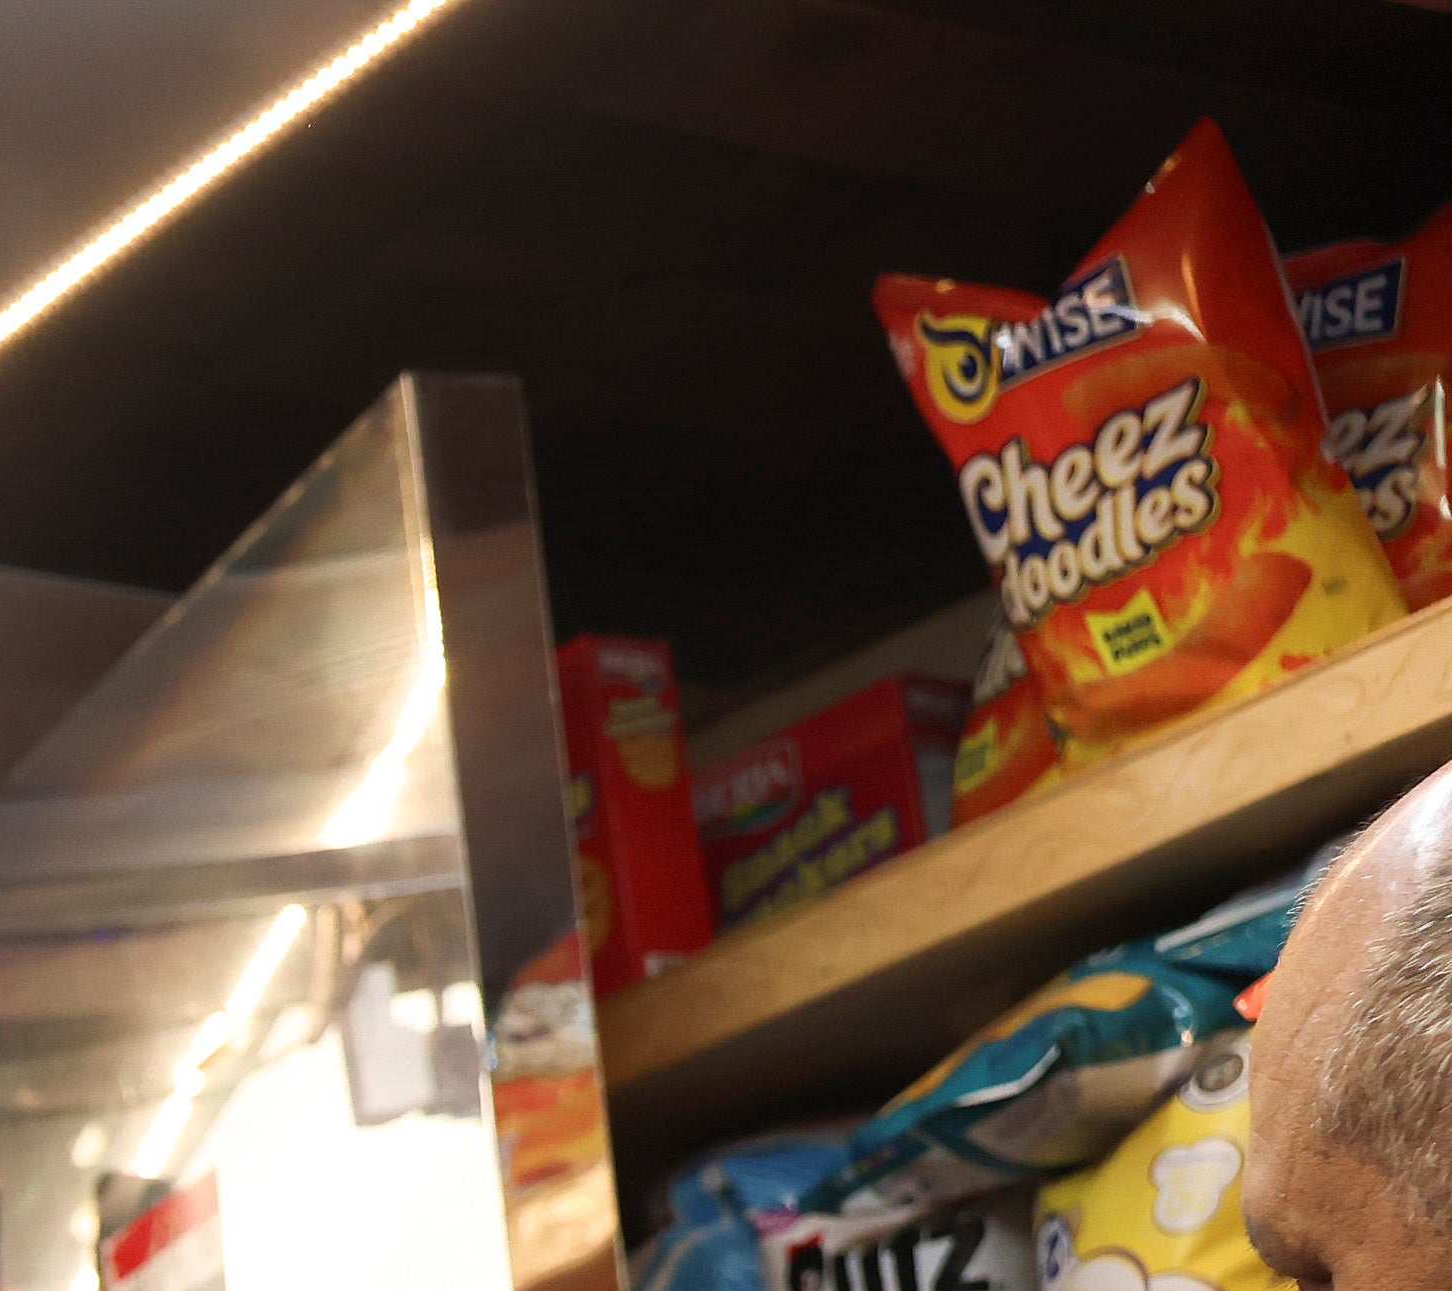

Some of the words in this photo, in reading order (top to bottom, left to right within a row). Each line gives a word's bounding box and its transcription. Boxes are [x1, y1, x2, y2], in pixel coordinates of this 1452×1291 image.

[998, 270, 1132, 375] WISE
[959, 378, 1210, 562] Cheez
[1001, 458, 1217, 626] doodles
